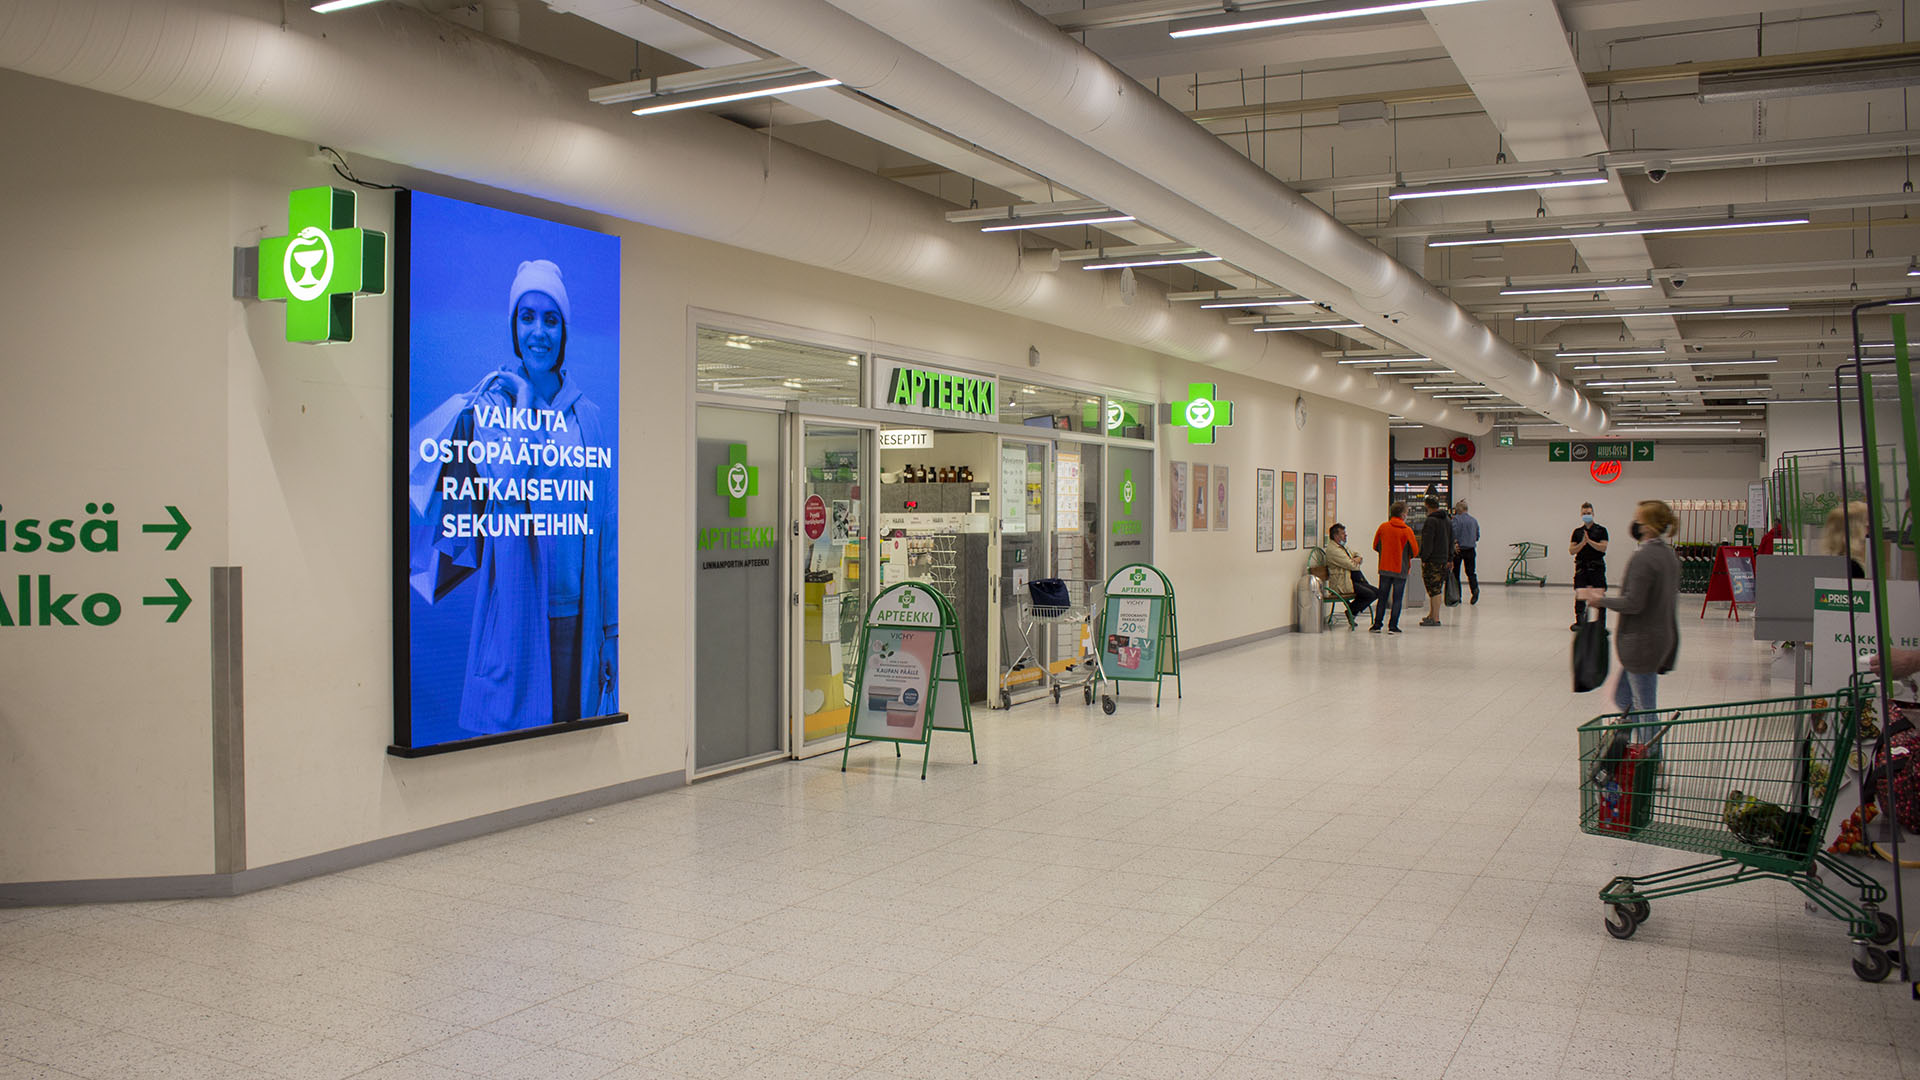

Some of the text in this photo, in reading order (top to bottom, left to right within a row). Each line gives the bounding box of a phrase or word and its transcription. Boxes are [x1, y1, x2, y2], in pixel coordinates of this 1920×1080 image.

[891, 367, 995, 415] APTEEKKI
[474, 404, 568, 432] VAIKUTA
[419, 436, 612, 468] OSTOPÄÄTÖKSEN
[442, 476, 594, 502] RATKAISEVIIN
[441, 513, 594, 538] SEKUNTEIHIN.
[699, 527, 774, 550] APTEEKKI
[703, 558, 770, 570] LINNANPORTIN APTEEKKI
[877, 610, 934, 624] APTEEKKI
[890, 632, 915, 641] VICHY
[876, 667, 900, 675] KAUPAN
